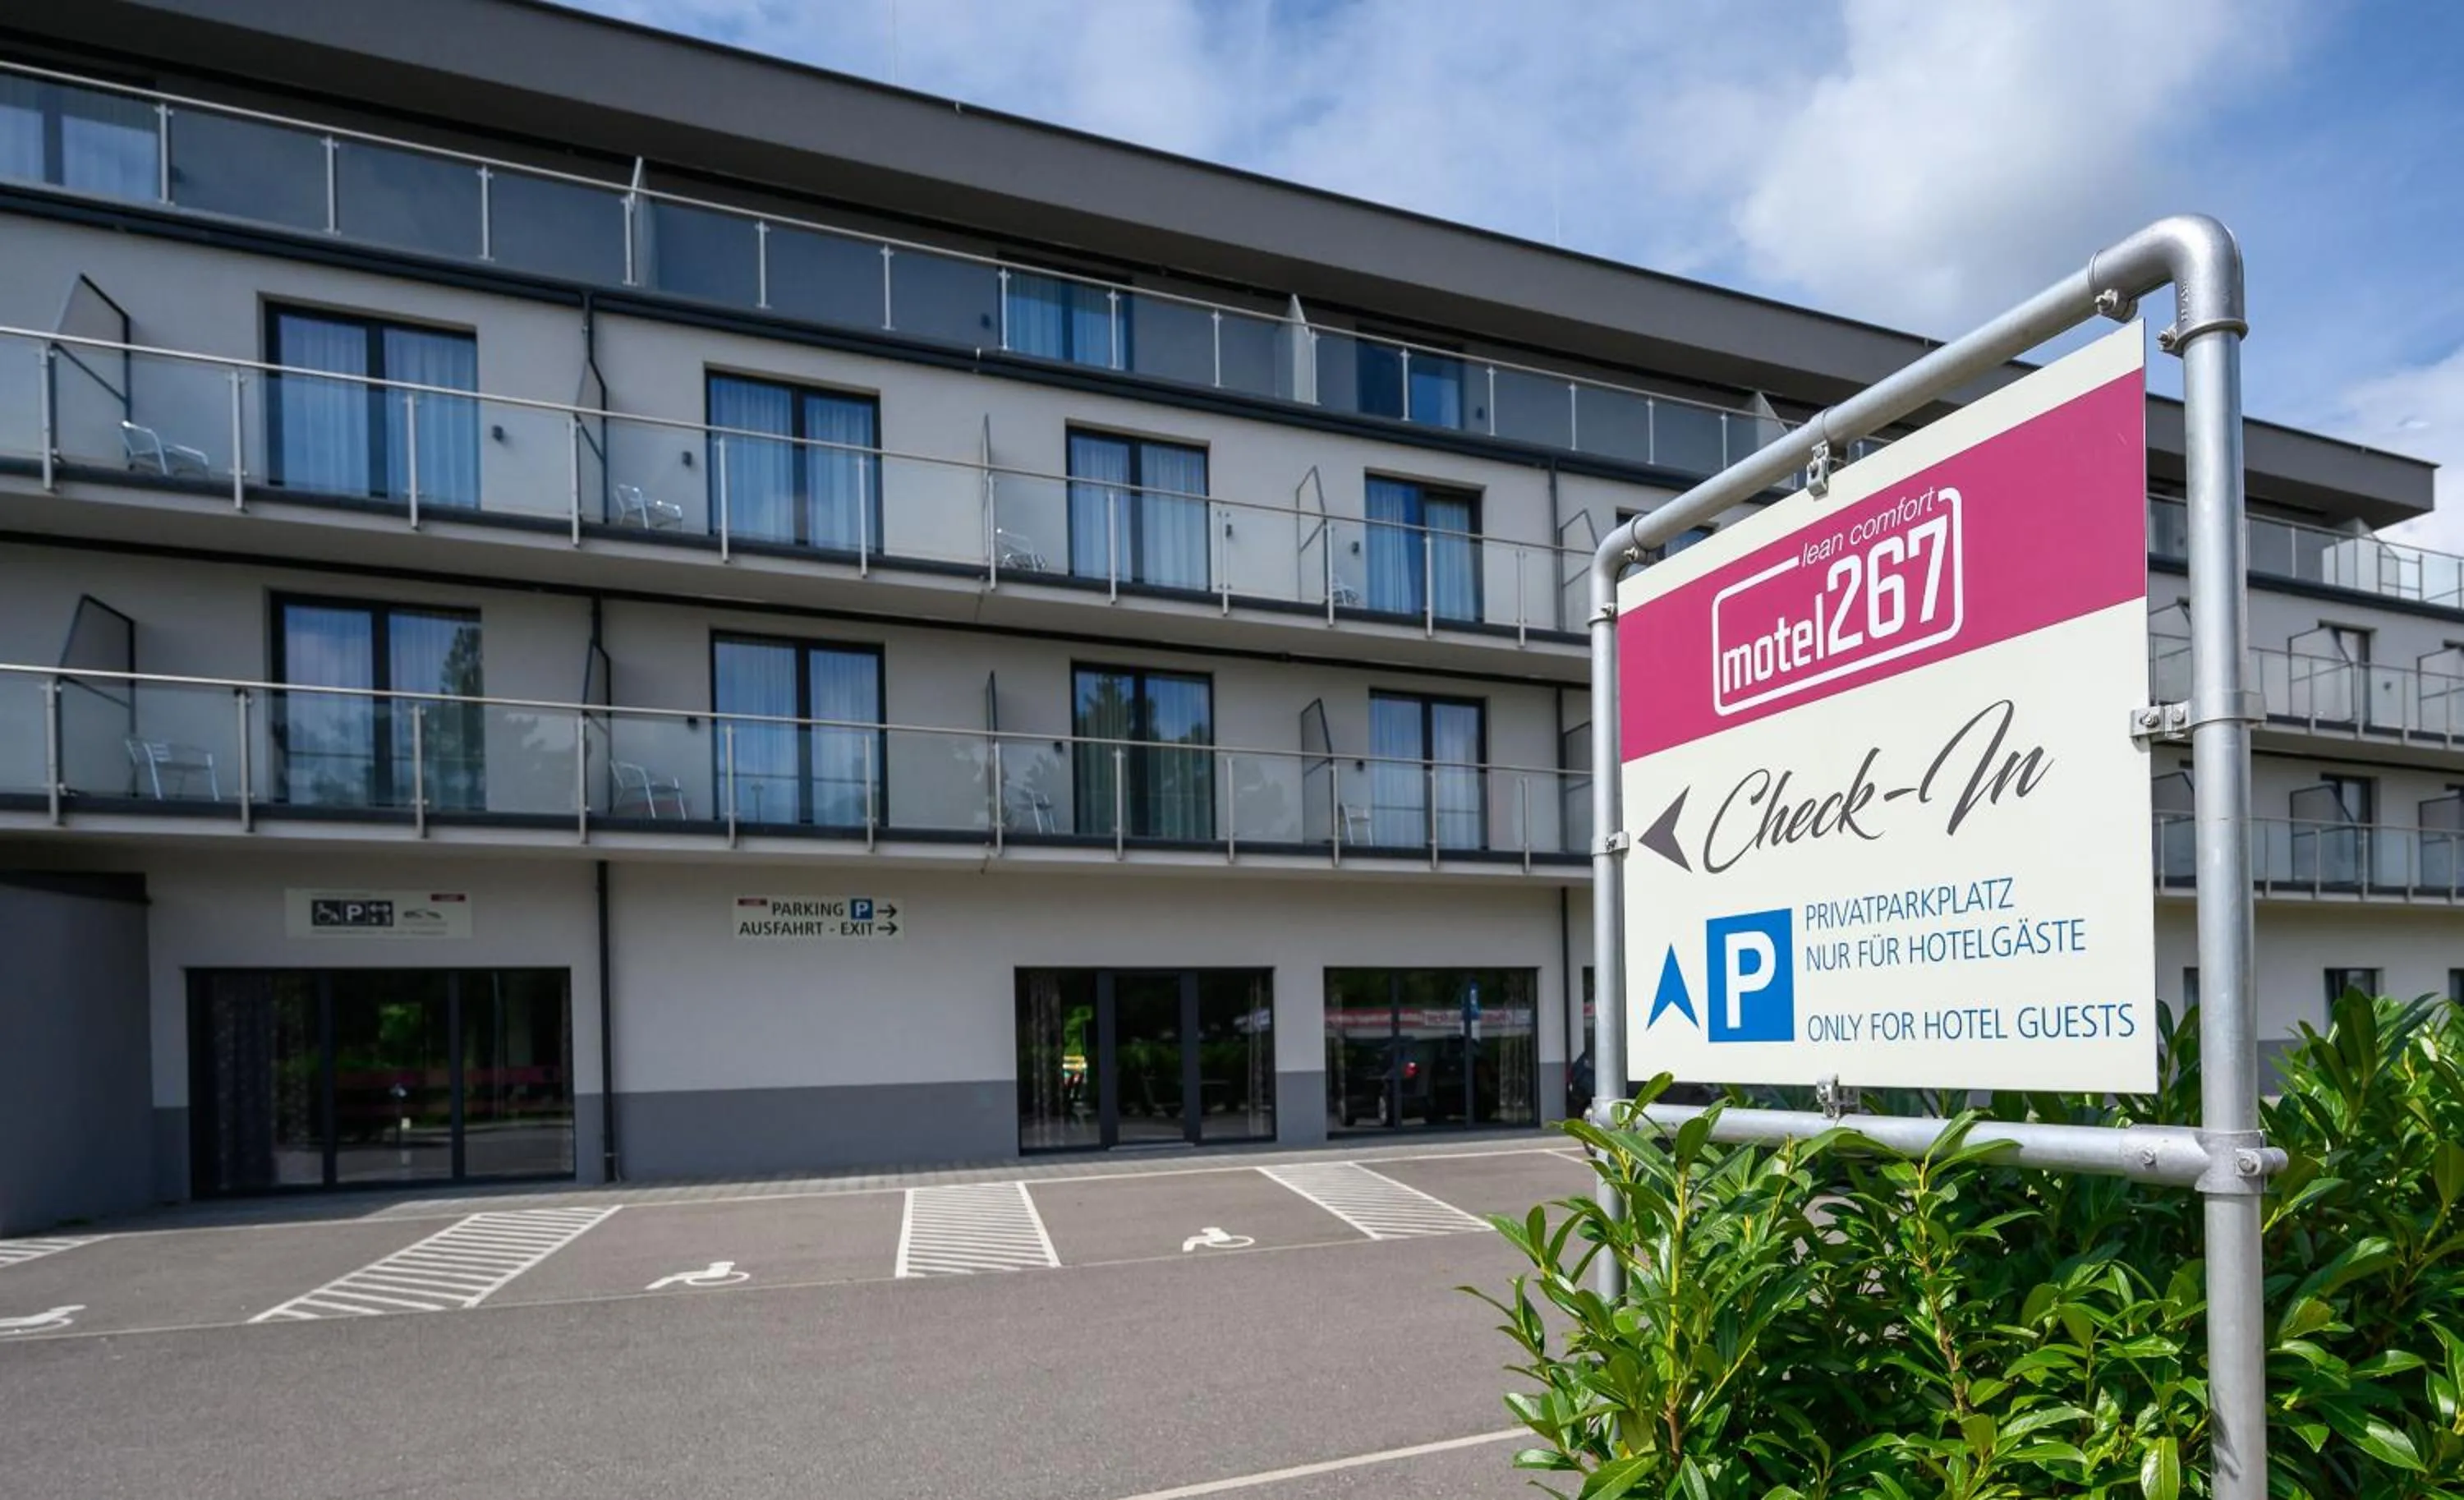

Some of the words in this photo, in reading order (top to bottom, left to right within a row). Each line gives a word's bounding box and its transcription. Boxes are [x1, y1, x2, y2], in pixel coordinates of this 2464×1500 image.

[1801, 532, 1844, 567] lean
[1850, 487, 1934, 545] comfort
[1703, 699, 2055, 873] Check-In
[346, 904, 363, 921] P
[739, 921, 824, 936] AUSFAHRT
[840, 921, 874, 936] EXIT
[772, 901, 844, 917] PARKING
[855, 901, 868, 917] P
[1806, 877, 2015, 931] PRIVATPARKPLATZ
[1806, 942, 1850, 972] NUR
[1859, 934, 1901, 968] FÜR
[1909, 918, 2087, 964] HOTELGÄSTE
[1726, 930, 1777, 1029] P
[1808, 1014, 1863, 1042] ONLY
[1872, 1011, 1916, 1041] FOR
[1924, 1009, 2008, 1040] HOTEL
[2017, 1003, 2135, 1038] GUESTS
